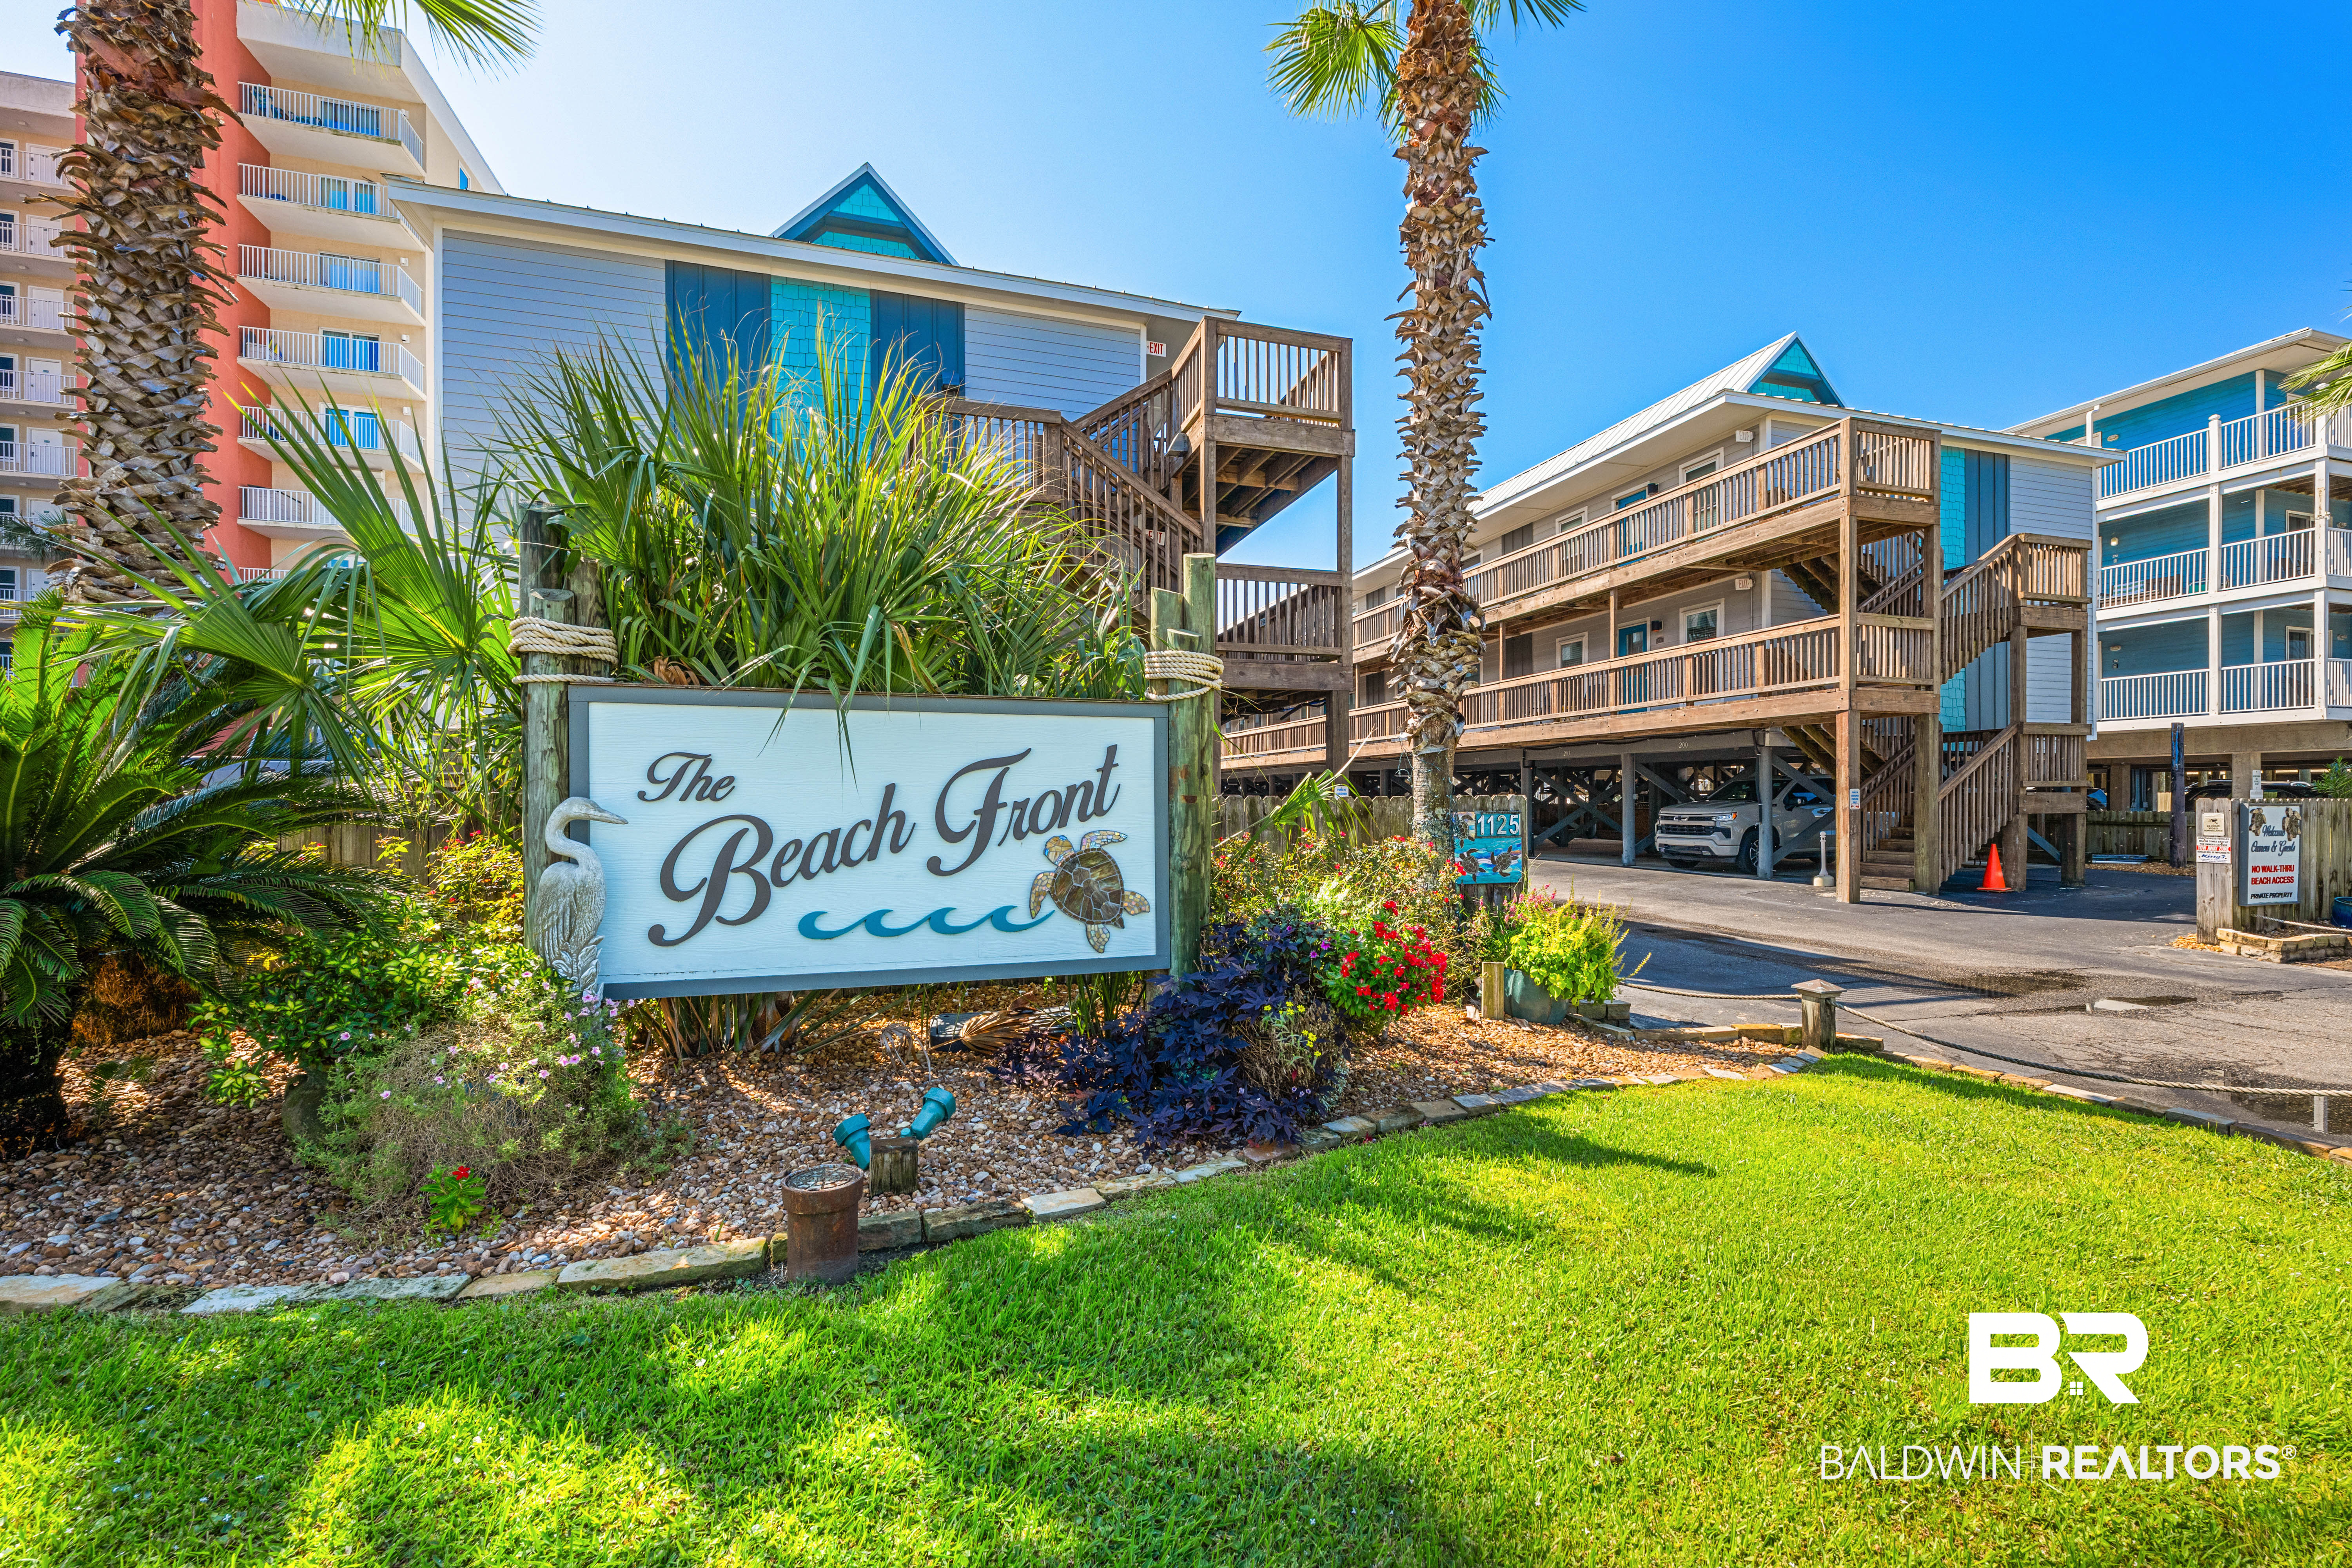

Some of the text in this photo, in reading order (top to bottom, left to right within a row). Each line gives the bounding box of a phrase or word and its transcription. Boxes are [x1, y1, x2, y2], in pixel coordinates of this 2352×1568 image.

[1149, 342, 1163, 355] EXIT
[1739, 431, 1748, 440] EXIT
[1149, 530, 1163, 543] EIT
[1739, 579, 1748, 588] EXIT
[637, 751, 736, 802] The
[1477, 815, 1519, 835] 1125
[2262, 825, 2286, 837] Welcome
[648, 744, 1121, 947] Beach Front
[2271, 840, 2277, 852] &
[2278, 840, 2296, 856] Guests
